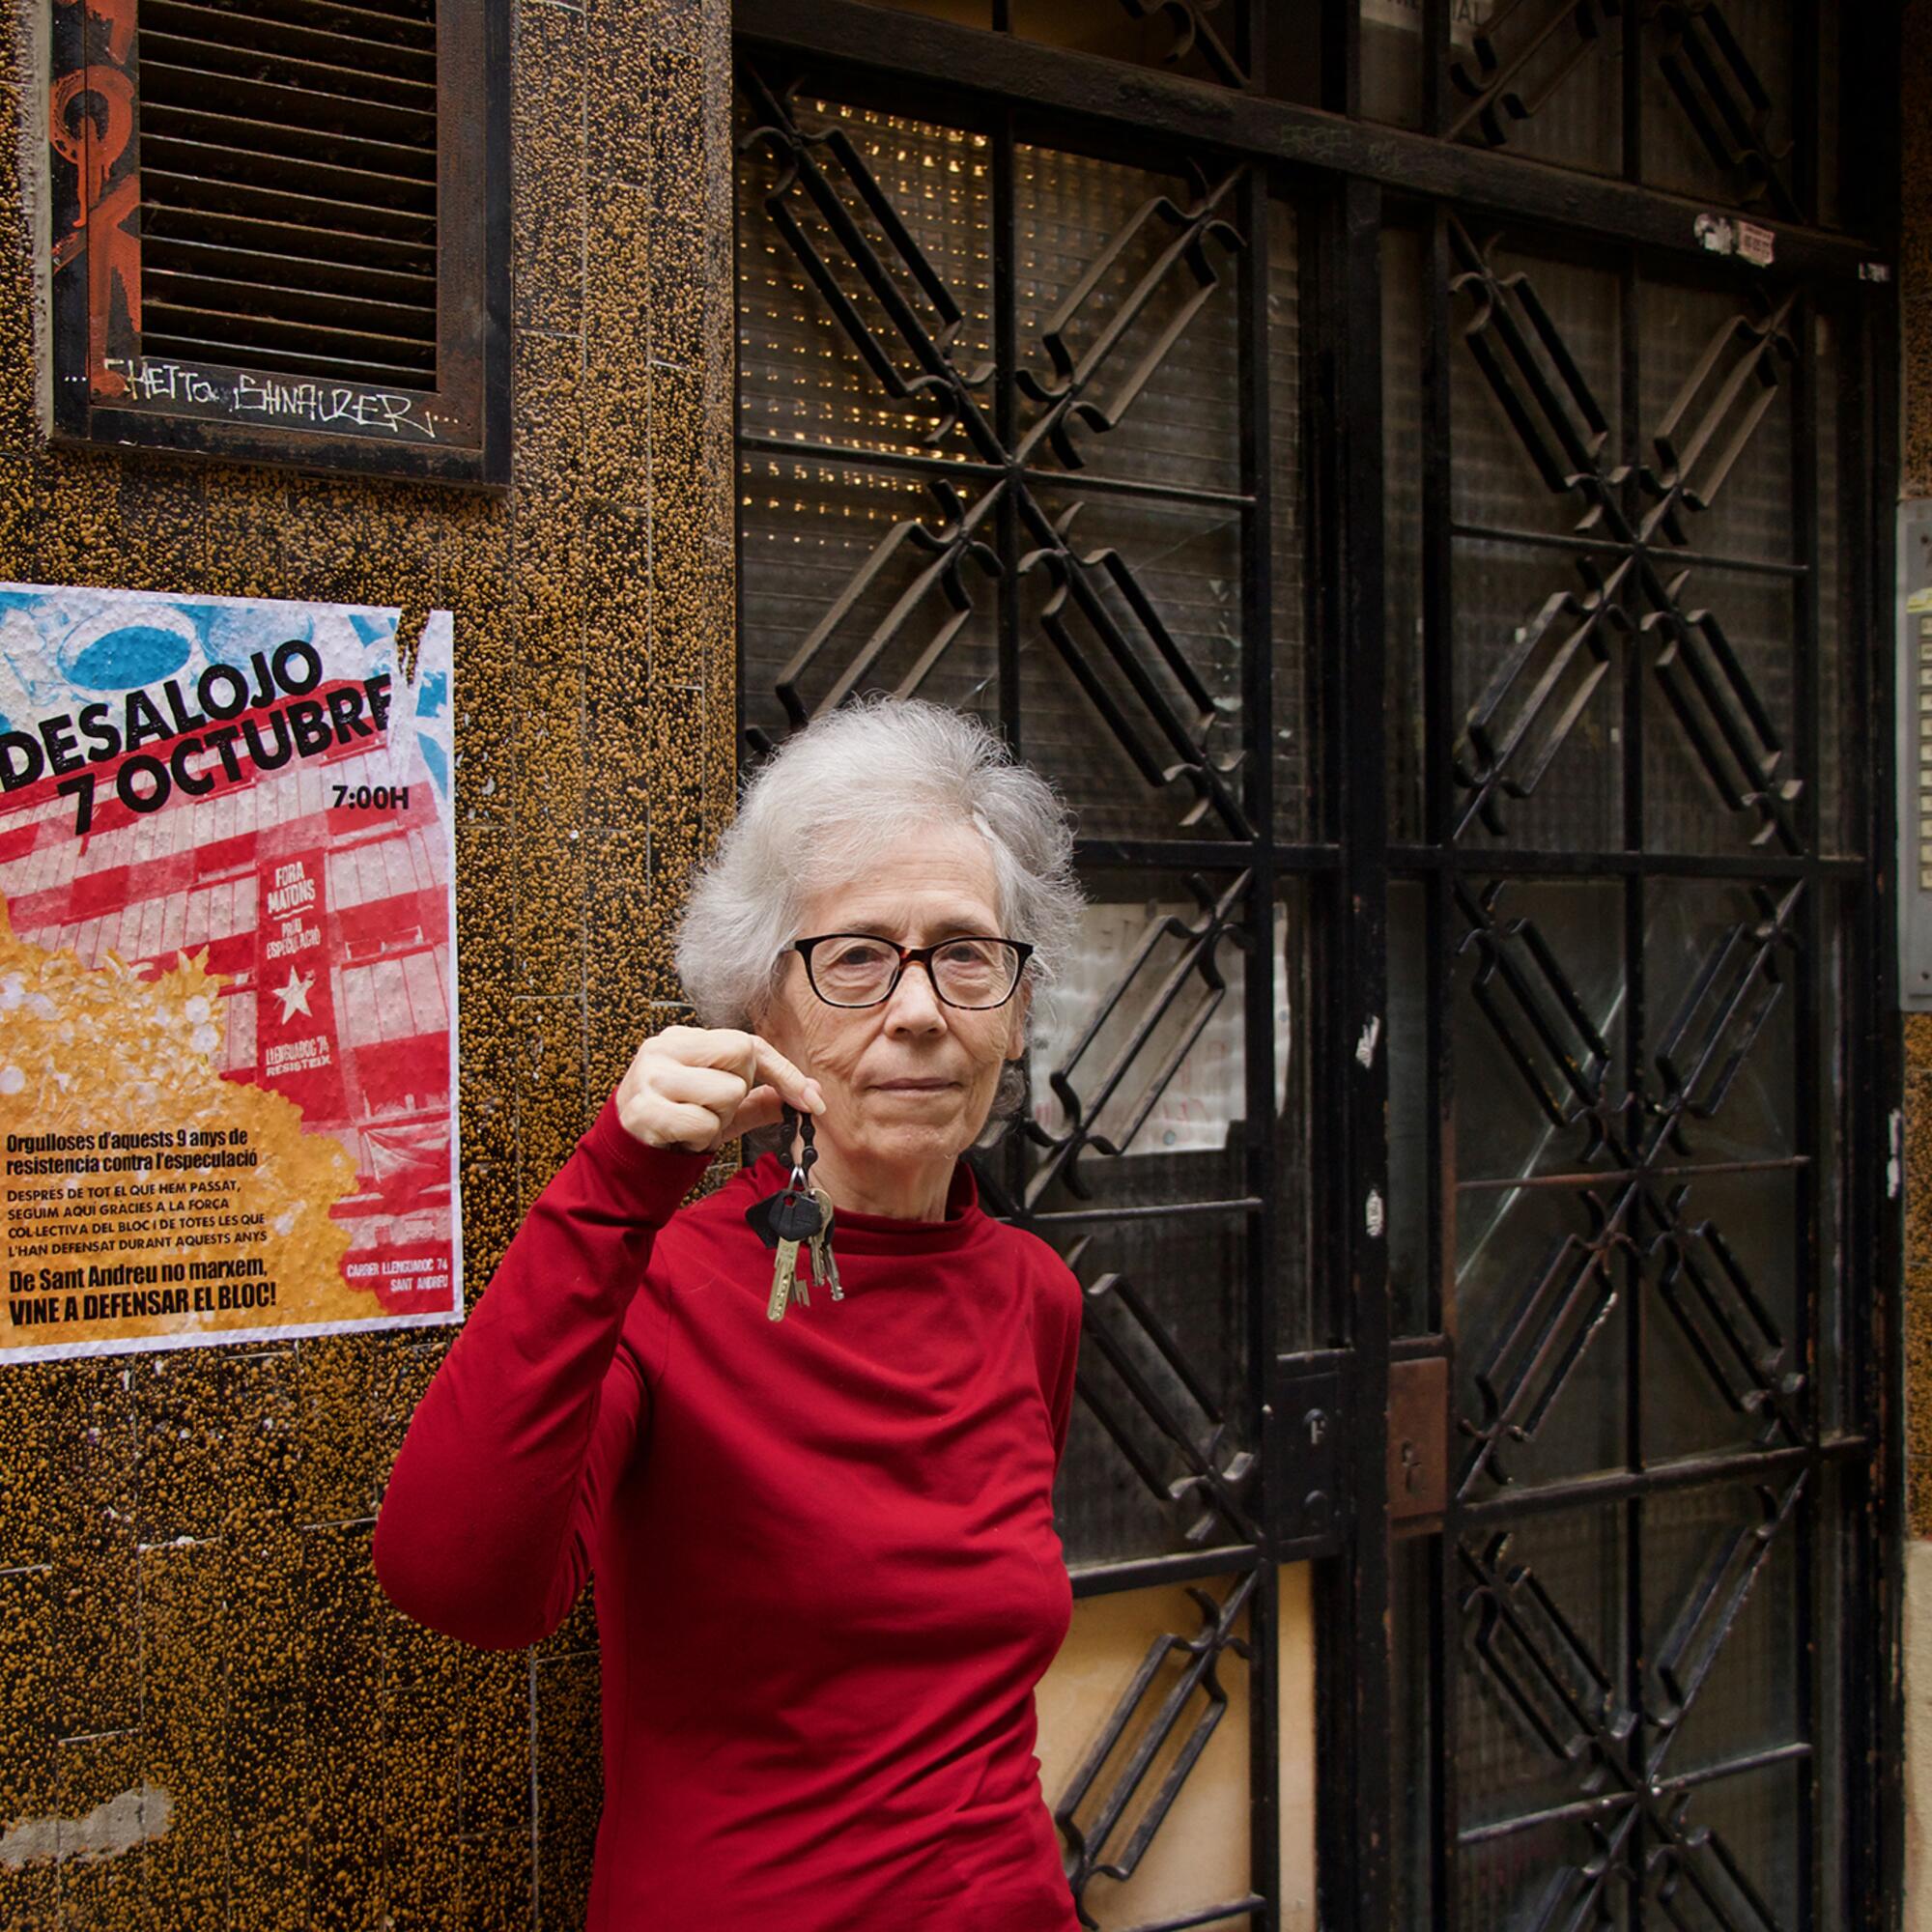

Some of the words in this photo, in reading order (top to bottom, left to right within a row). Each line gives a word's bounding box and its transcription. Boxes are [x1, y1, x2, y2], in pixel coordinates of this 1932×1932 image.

[0, 639, 323, 791] DESALOJO
[57, 773, 95, 835] 7
[332, 785, 410, 810] 7:00H
[275, 861, 305, 888] FORA
[268, 878, 317, 915] MATONS
[7, 1133, 95, 1154] Orgulloses
[99, 1130, 174, 1151] d'aquests
[177, 1129, 186, 1147] 9
[189, 1130, 226, 1148] anys
[229, 1128, 247, 1145] de
[103, 1154, 153, 1172] contra
[156, 1148, 257, 1171] l'especulació
[68, 1187, 83, 1199] DE
[88, 1186, 110, 1198] TOT
[114, 1185, 127, 1197] EL
[129, 1183, 155, 1196] QUE
[159, 1182, 185, 1194] HEM
[190, 1180, 241, 1193] PASSAT,
[8, 1207, 59, 1220] SEGUIM
[156, 1201, 165, 1212] A
[169, 1200, 185, 1211] LA
[188, 1198, 229, 1210] FORÇA
[92, 1222, 114, 1234] DEL
[118, 1219, 149, 1233] BLOC
[153, 1218, 156, 1230] I
[159, 1218, 176, 1230] DE
[179, 1215, 214, 1228] TOTES
[218, 1215, 239, 1226] LES
[241, 1213, 265, 1225] QUE
[8, 1243, 47, 1258] L'HAN
[51, 1240, 115, 1255] DEFENSAT
[119, 1236, 171, 1250] DURANT
[175, 1233, 230, 1247] AQUESTS
[234, 1231, 267, 1243] ANYS
[10, 1270, 35, 1293] De
[39, 1267, 84, 1291] Sant
[88, 1264, 157, 1288] Andreu
[161, 1263, 185, 1283] no
[189, 1258, 268, 1281] marxem,
[390, 1277, 413, 1293] SANT
[416, 1274, 448, 1290] ANDREU
[9, 1296, 60, 1326] VINE
[64, 1295, 78, 1321] A
[83, 1288, 188, 1321] DEFENSAR
[194, 1286, 214, 1312] EL
[218, 1282, 276, 1310] BLOC!
